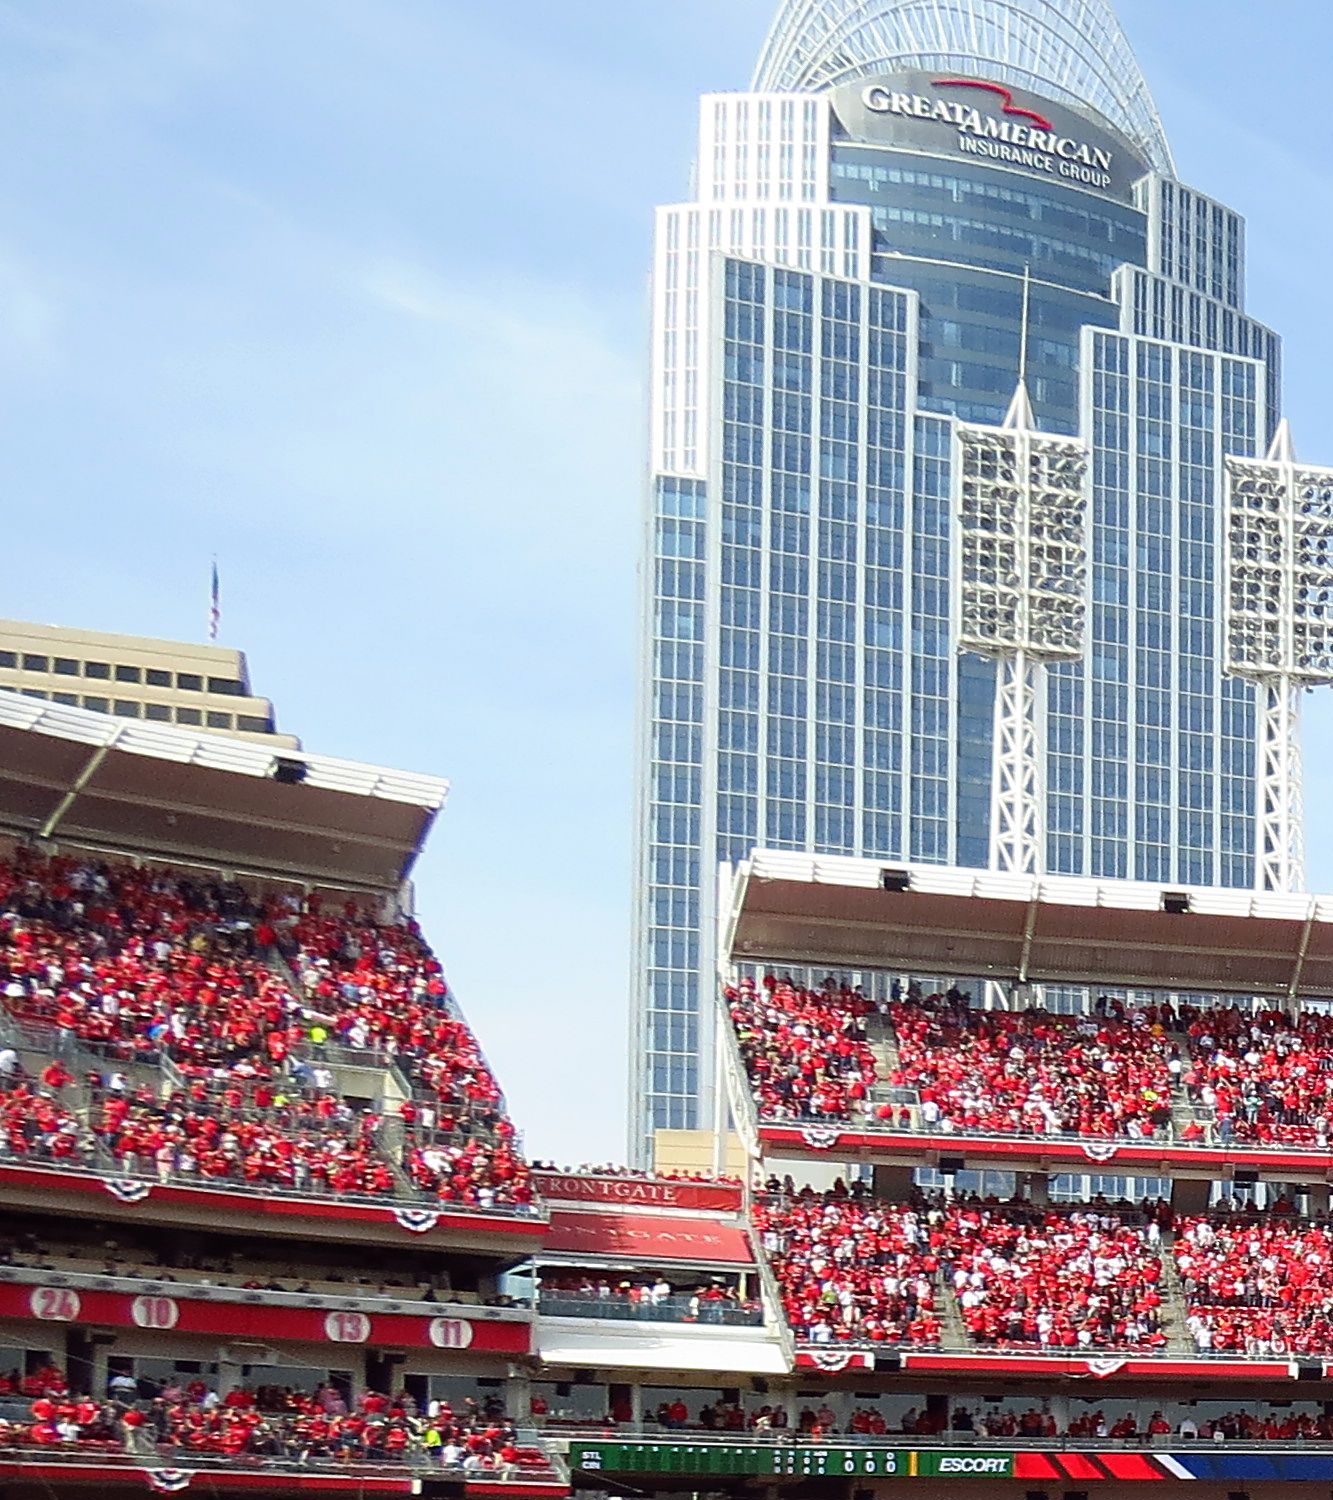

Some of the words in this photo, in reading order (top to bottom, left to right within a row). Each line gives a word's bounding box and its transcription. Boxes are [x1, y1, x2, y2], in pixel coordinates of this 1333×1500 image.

[959, 136, 1054, 173] INSURANCE
[1058, 162, 1113, 189] GROUP
[535, 1177, 677, 1201] FRONTGATE
[140, 1299, 170, 1326] 10
[440, 1320, 462, 1347] 11
[582, 1451, 601, 1460] STL
[844, 1460, 855, 1473] 0
[864, 1460, 876, 1473] 0
[886, 1460, 897, 1473] 0
[938, 1458, 1011, 1473] ESCORT
